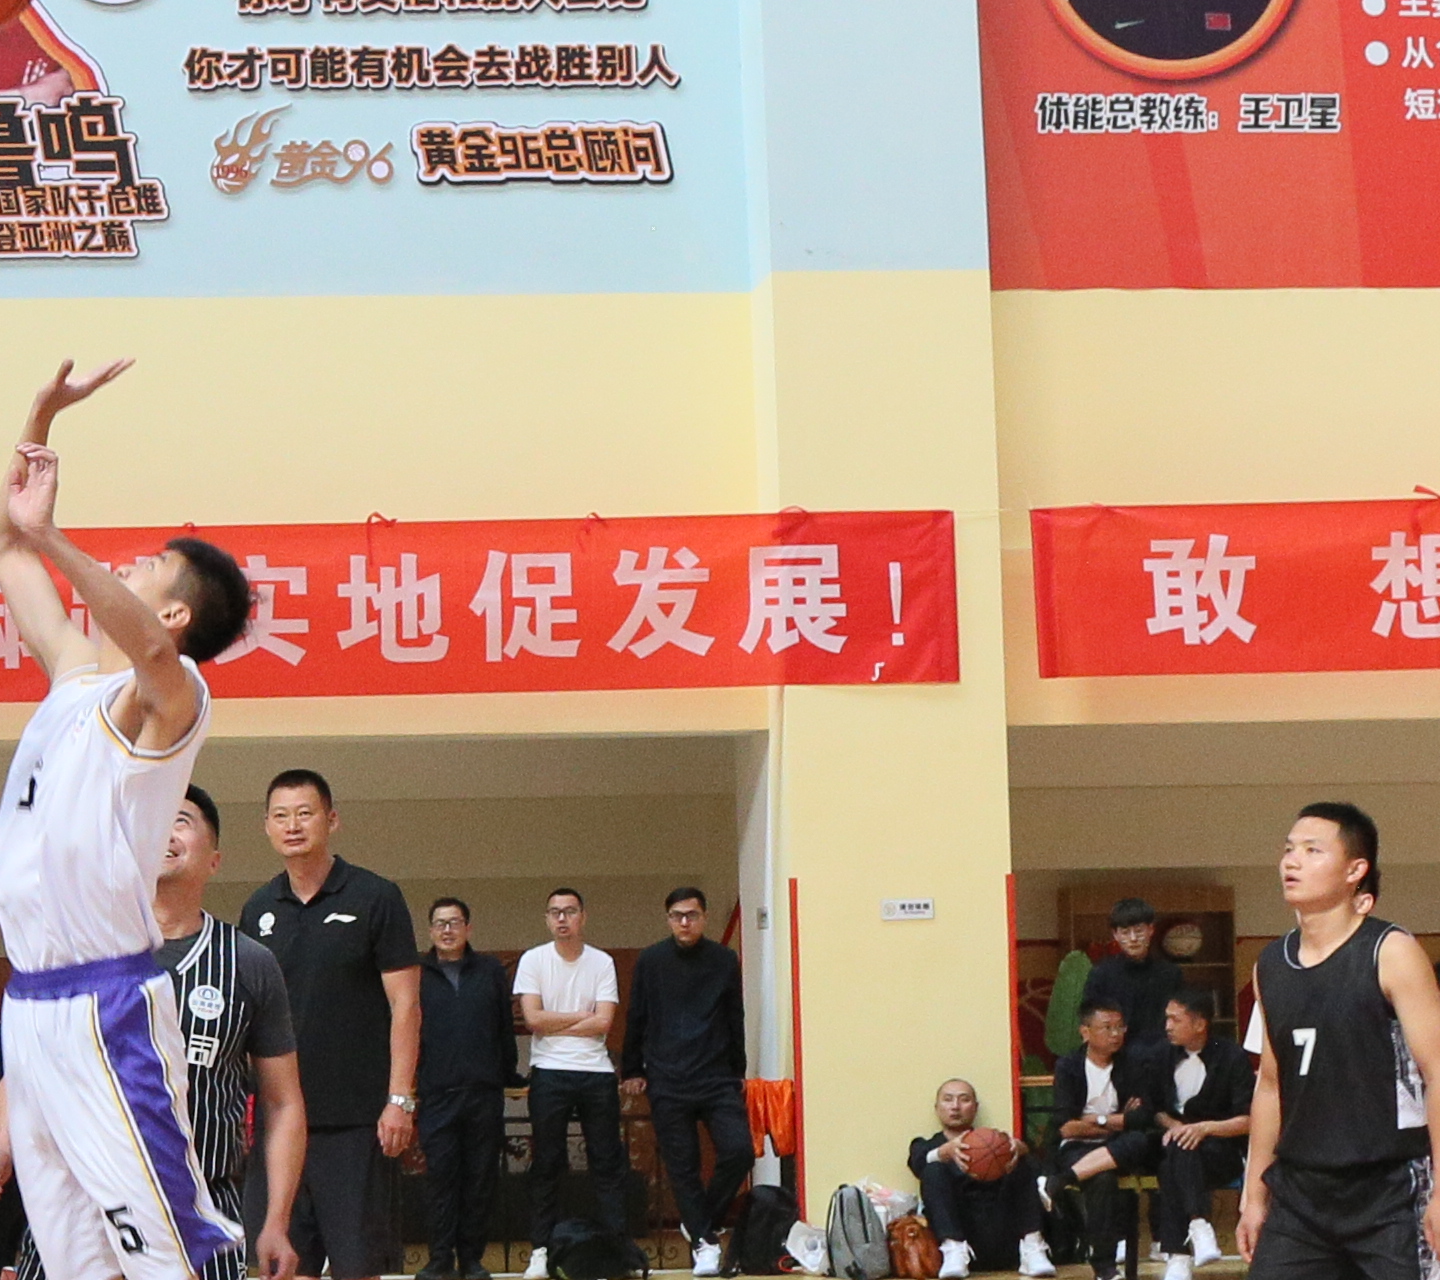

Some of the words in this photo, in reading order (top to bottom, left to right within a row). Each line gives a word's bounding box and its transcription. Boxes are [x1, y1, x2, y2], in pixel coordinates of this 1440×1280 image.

[184, 44, 681, 88] 你才可能有机会去战胜别人
[269, 141, 394, 188] 黄金96
[418, 125, 664, 176] 黄金96总顾问
[1292, 1027, 1317, 1077] 7
[105, 1204, 150, 1255] 5
